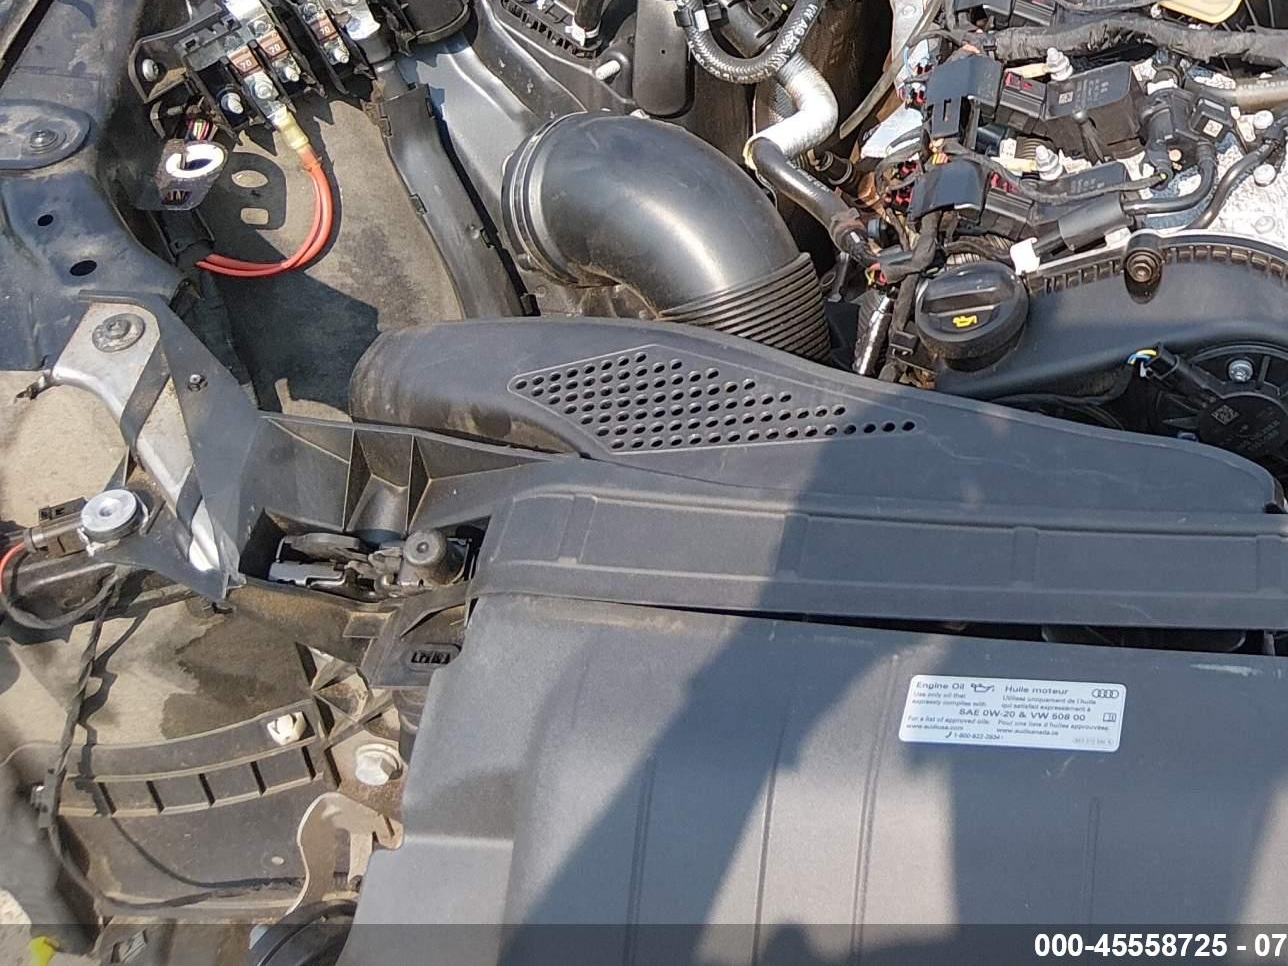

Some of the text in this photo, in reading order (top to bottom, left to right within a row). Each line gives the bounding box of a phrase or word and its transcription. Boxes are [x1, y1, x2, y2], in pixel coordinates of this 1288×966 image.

[916, 681, 966, 690] Engine Oil
[1005, 685, 1069, 695] Huile moteur
[959, 708, 981, 716] SAE
[982, 709, 1016, 718] 0W-20
